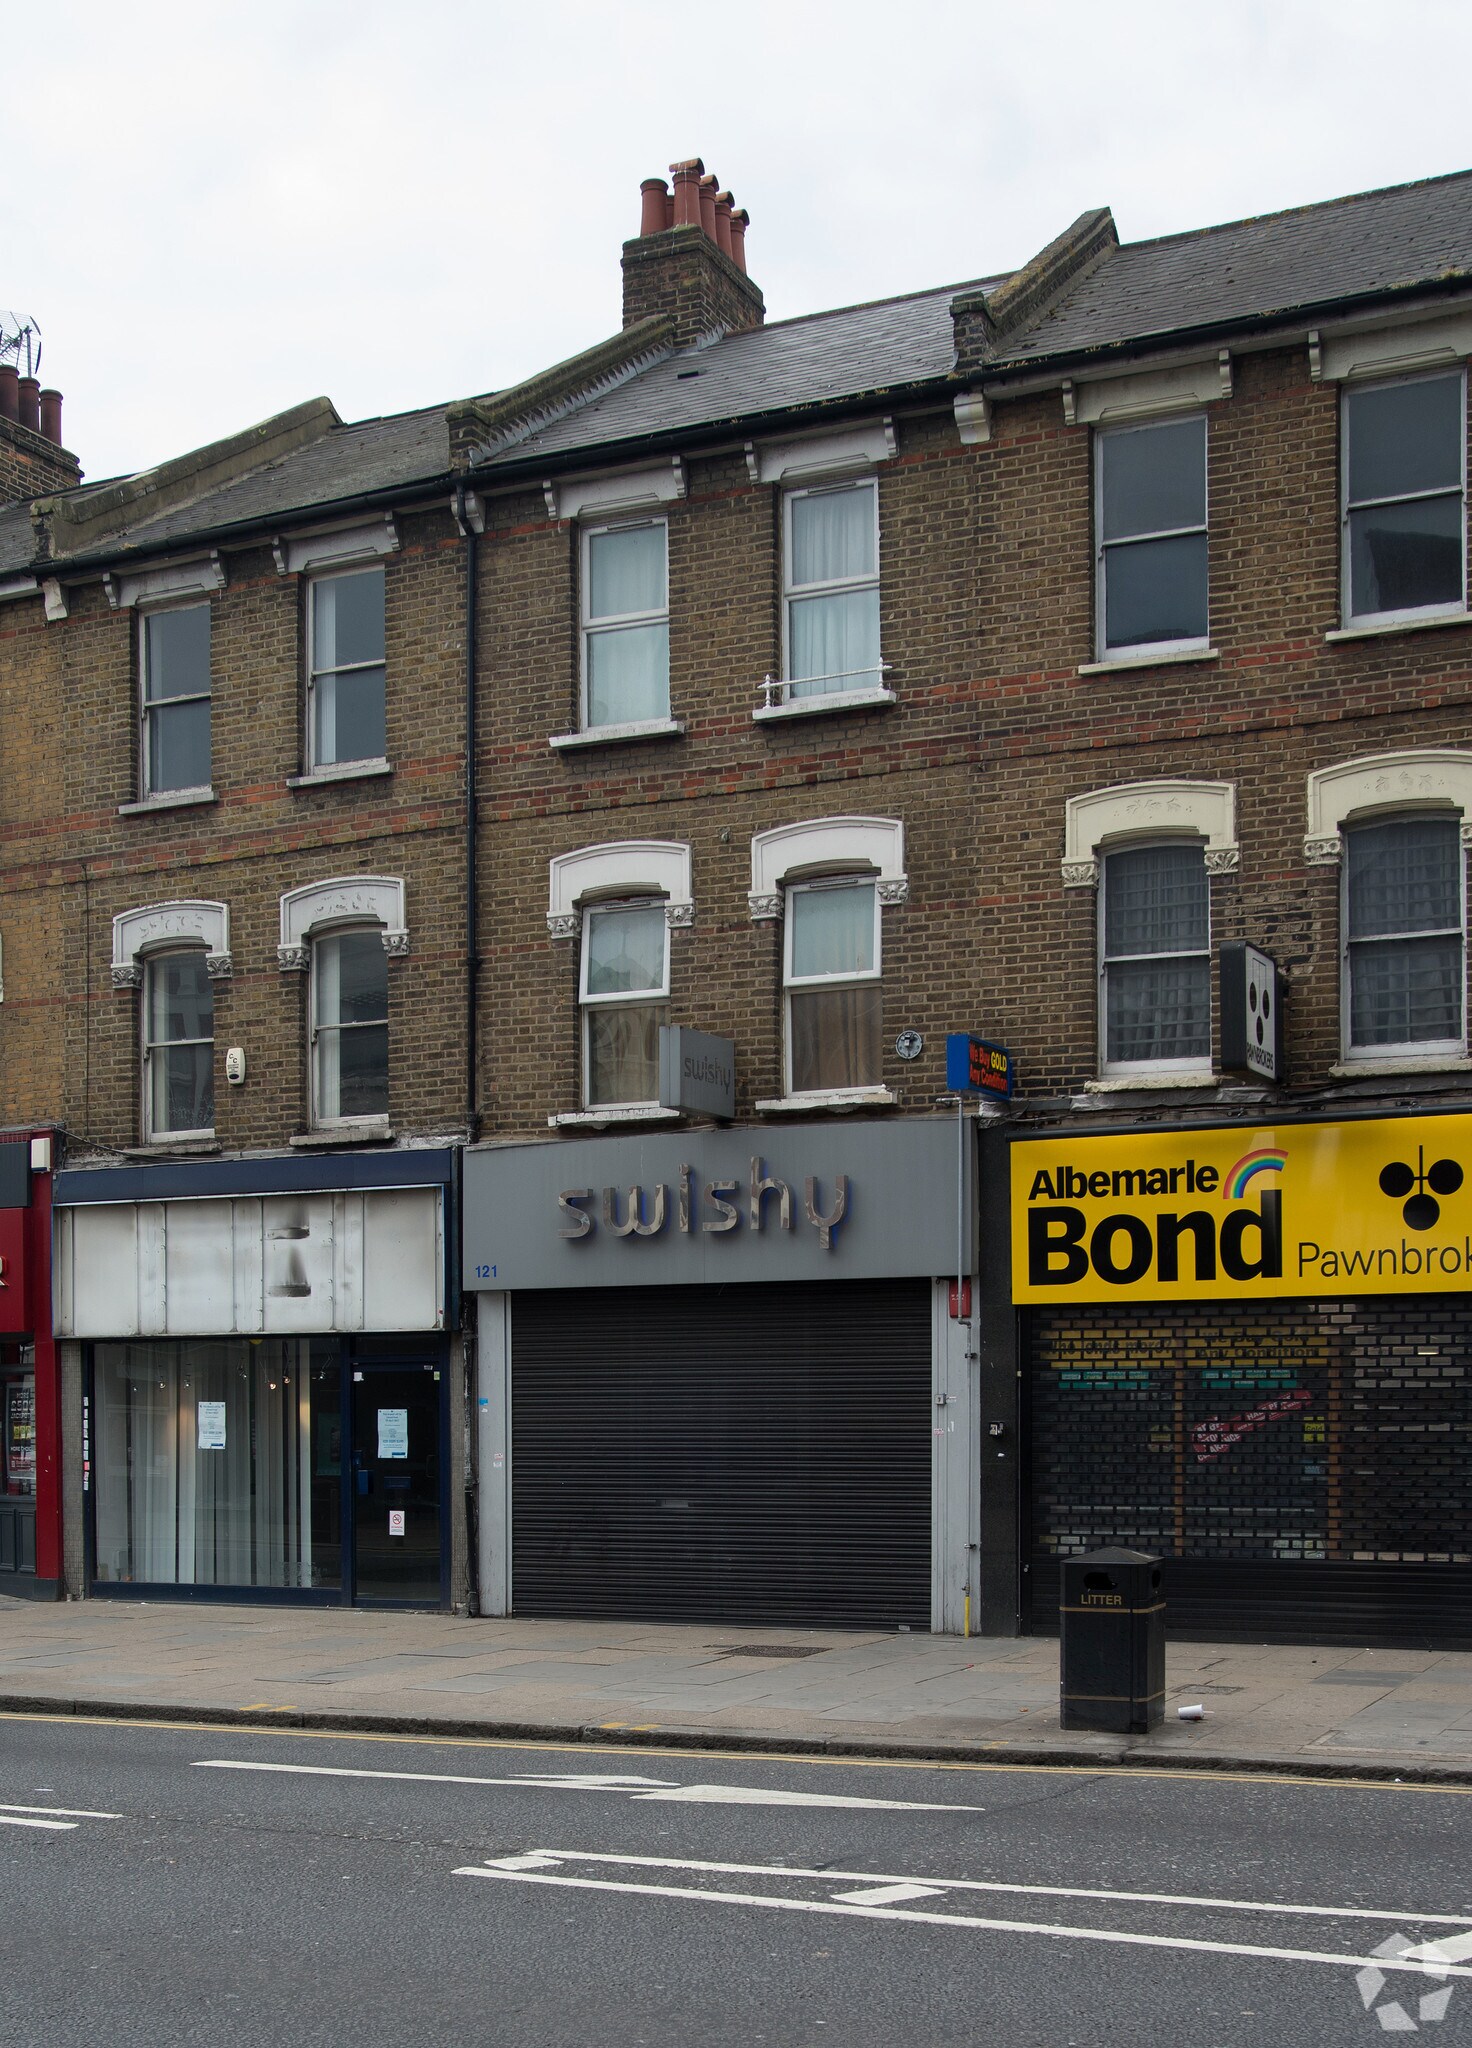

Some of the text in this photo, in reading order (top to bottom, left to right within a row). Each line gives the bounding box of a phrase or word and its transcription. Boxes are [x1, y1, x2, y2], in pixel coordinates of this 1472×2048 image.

[684, 1055, 731, 1095] swishy
[991, 1051, 1007, 1072] GOLD
[1028, 1159, 1219, 1201] Albemarle
[557, 1156, 848, 1250] swishy
[1028, 1189, 1283, 1287] Bond
[475, 1264, 497, 1278] 121
[1080, 1594, 1122, 1606] LITTER
